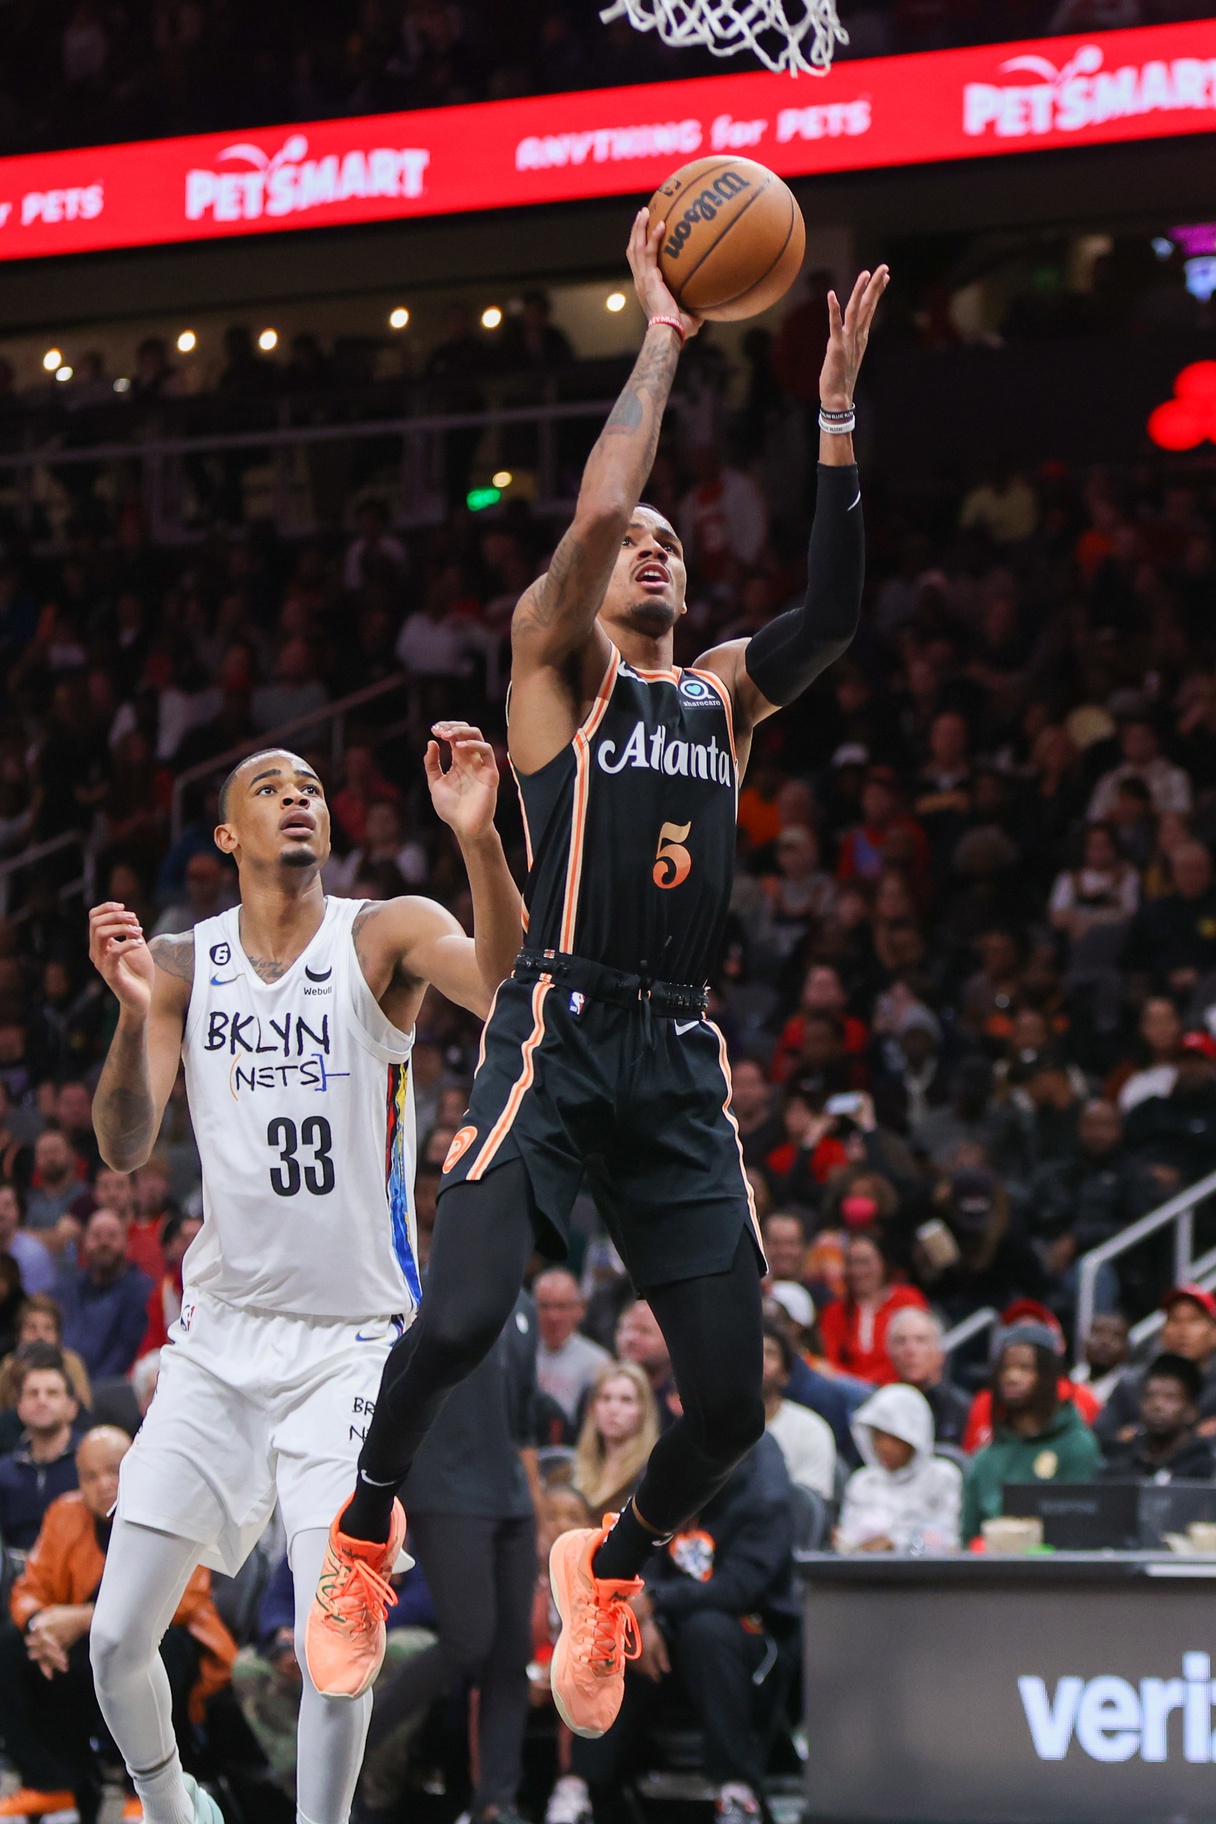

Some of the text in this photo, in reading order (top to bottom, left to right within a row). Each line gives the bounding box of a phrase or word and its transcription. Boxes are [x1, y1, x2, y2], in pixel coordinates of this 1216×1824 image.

[515, 100, 871, 171] ANYTHING for PETS
[20, 184, 104, 227] PETS
[185, 147, 430, 222] PETSMART
[663, 171, 751, 259] Wilson
[598, 721, 731, 787] Atlanta
[652, 820, 692, 889] 5
[213, 944, 229, 964] 6
[303, 986, 333, 996] Webull
[204, 1012, 330, 1056] BKLYN
[267, 1116, 335, 1197] 33
[1017, 1650, 1216, 1764] veri
